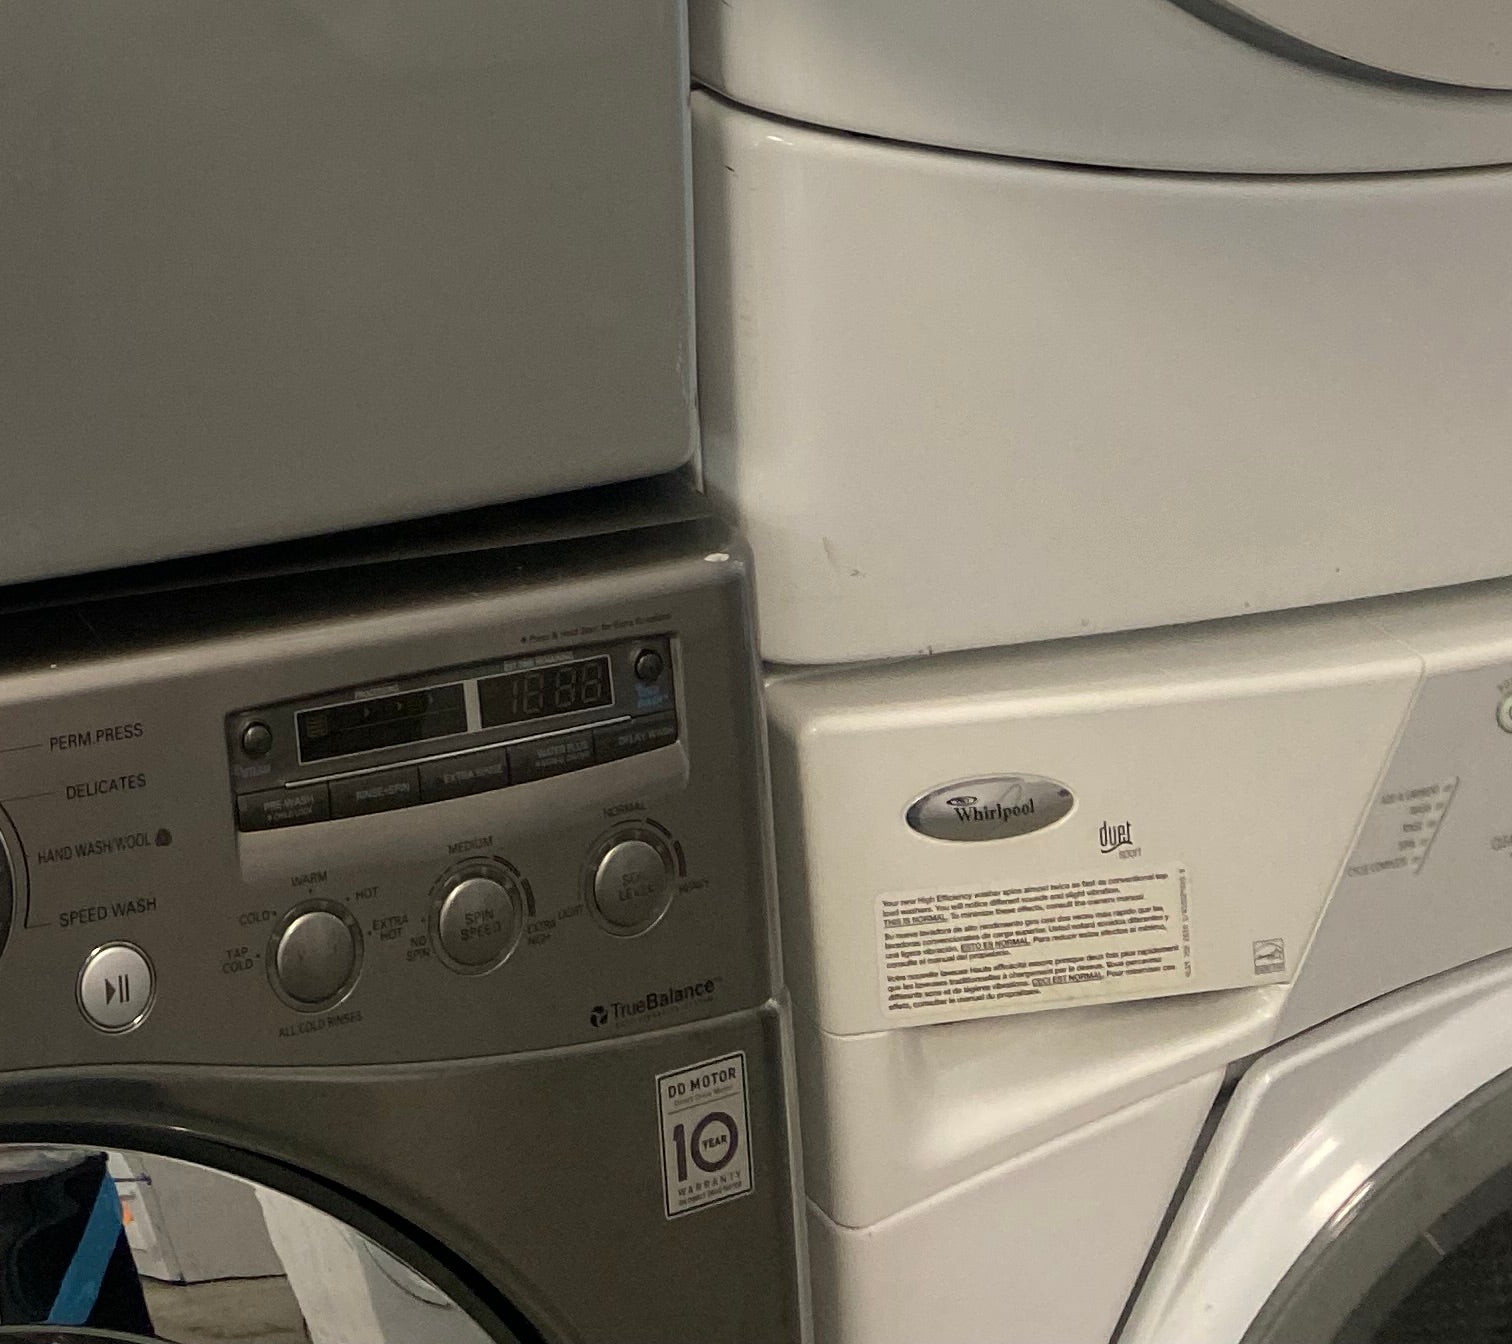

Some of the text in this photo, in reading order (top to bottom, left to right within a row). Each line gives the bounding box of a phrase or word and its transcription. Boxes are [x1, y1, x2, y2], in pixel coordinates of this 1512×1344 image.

[66, 773, 147, 800] DELICATES
[602, 800, 647, 819] NORMAL
[954, 798, 1036, 824] Whirlpool
[446, 835, 494, 855] MEDIUM
[1098, 820, 1133, 854] duet
[38, 832, 151, 864] HAND WASH/WOOL
[291, 871, 328, 887] WARM
[239, 887, 379, 927] COLD HOT
[917, 893, 972, 905] High Efficiency
[59, 896, 158, 928] SPEED WASH
[464, 910, 495, 926] SPIN
[372, 915, 409, 931] EXTRA
[460, 922, 502, 942] SPEED
[379, 928, 403, 941] HOT
[409, 935, 427, 948] NO
[226, 947, 249, 960] TAP
[406, 947, 432, 963] SPIN
[221, 958, 254, 974] COLD
[610, 978, 717, 1020] TrueBalance
[667, 1066, 737, 1099] DD MOTOR
[673, 1111, 739, 1183] 10
[702, 1134, 728, 1151] YEAR
[678, 1170, 742, 1197] WARRANTY
